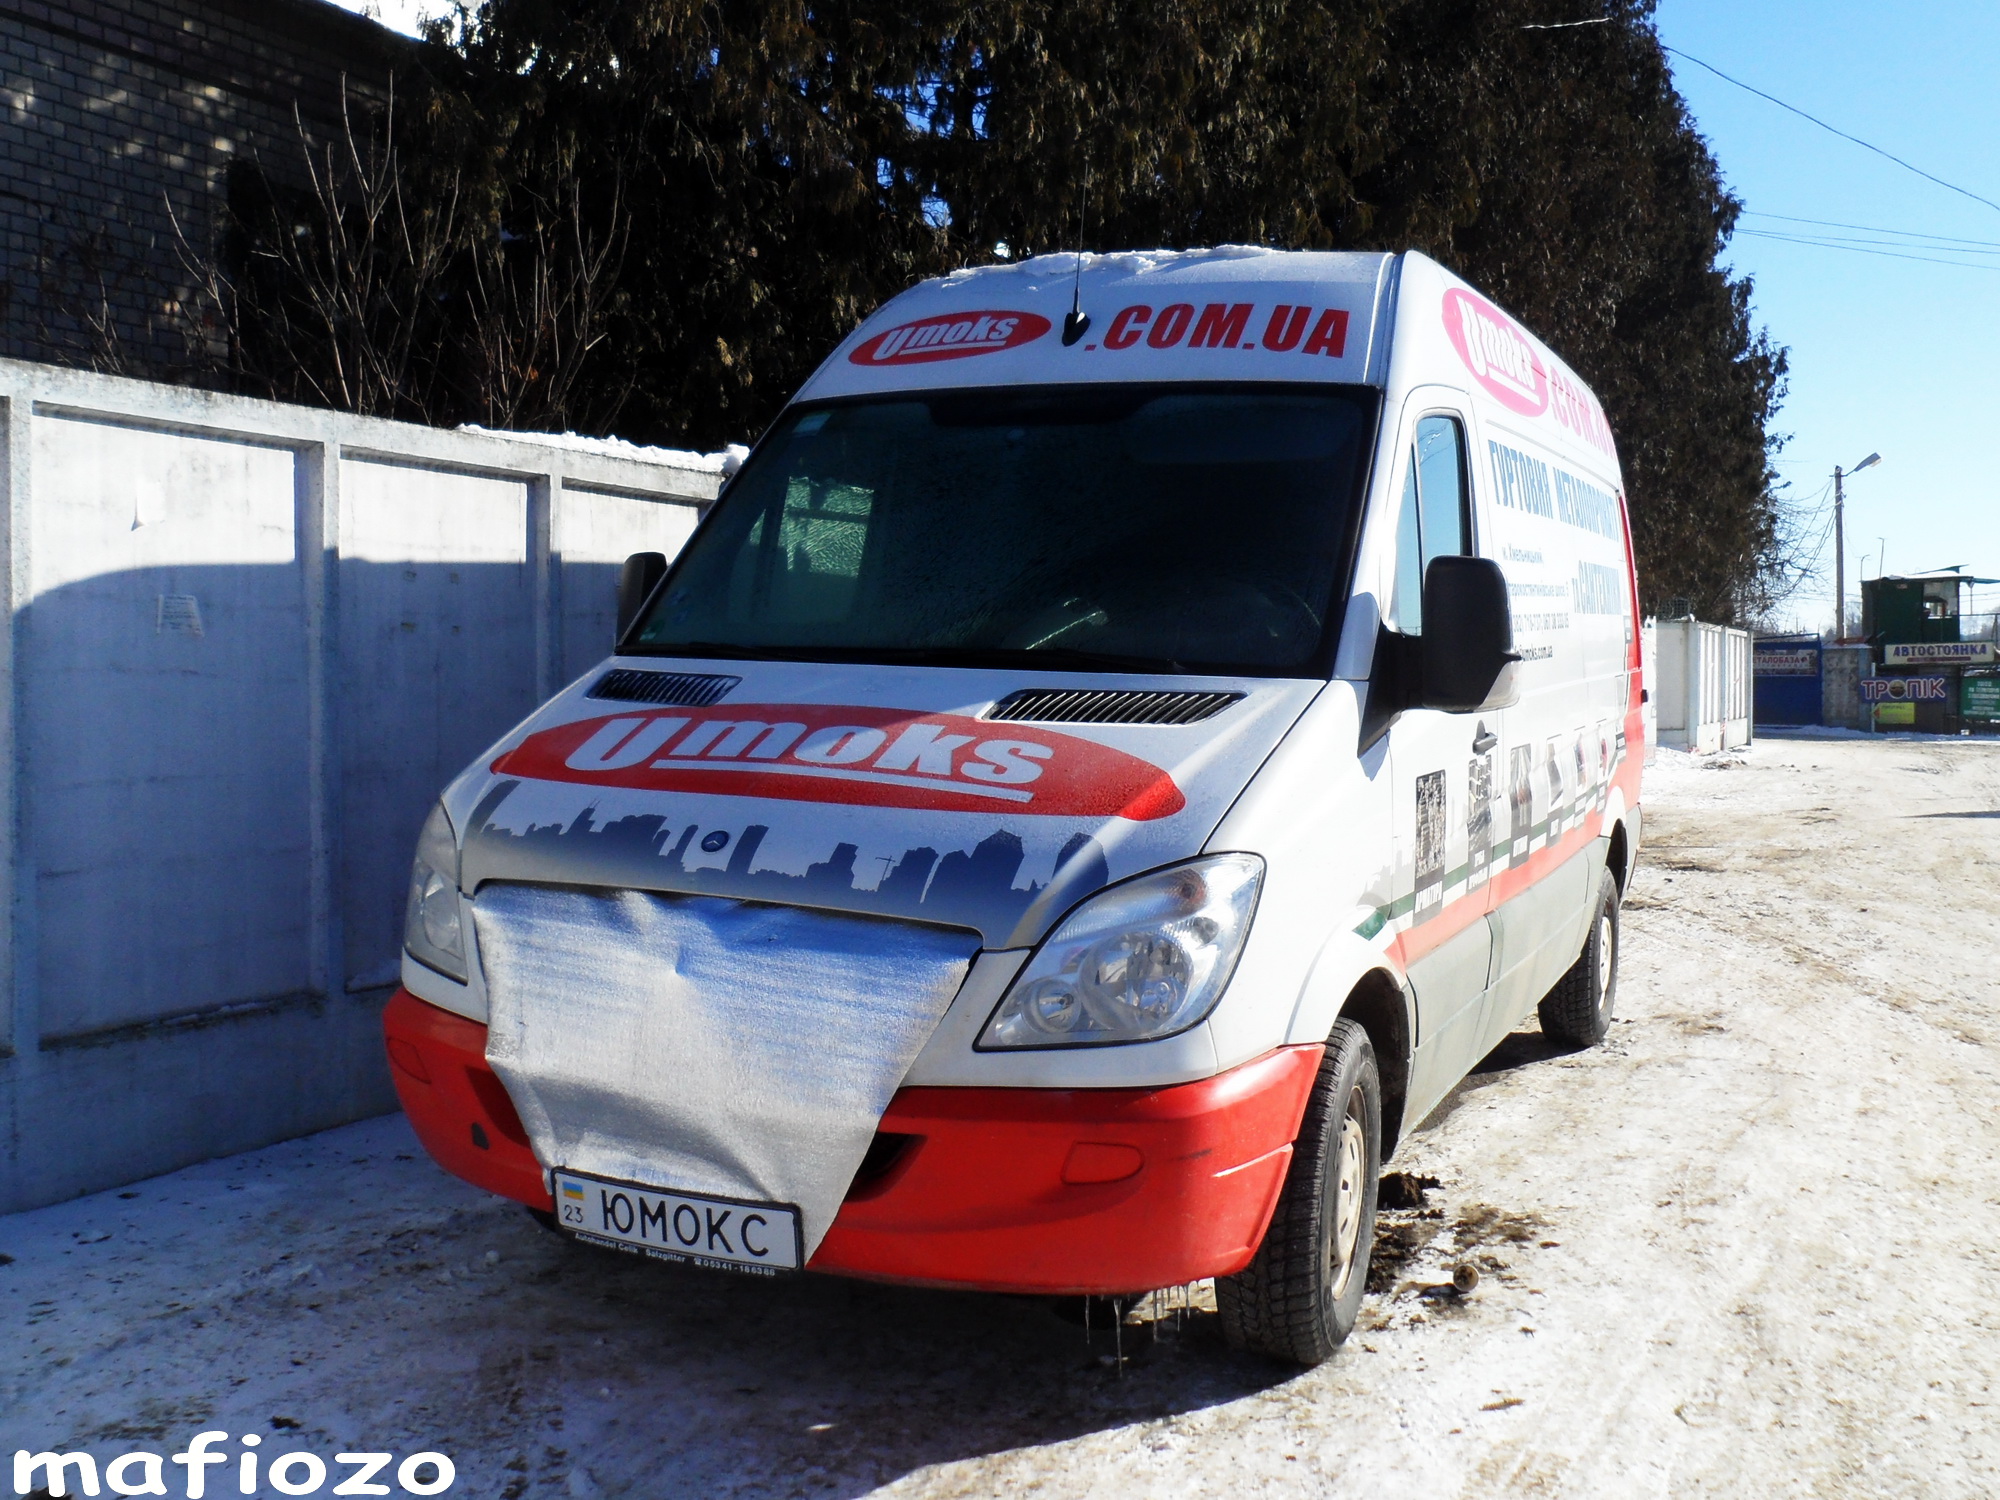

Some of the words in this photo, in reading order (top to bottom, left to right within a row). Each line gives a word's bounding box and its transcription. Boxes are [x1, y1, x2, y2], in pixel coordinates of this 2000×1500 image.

[875, 315, 1019, 361] Umoks
[1084, 303, 1350, 358] .COM.UA
[1455, 295, 1536, 391] Umoks
[1488, 439, 1553, 519] ГУРТОВНЯ
[1892, 643, 1987, 657] АВТОСТОЯНКА
[565, 716, 1053, 786] Umoks
[563, 1204, 584, 1224] 23
[601, 1189, 769, 1257] ЮМОКС
